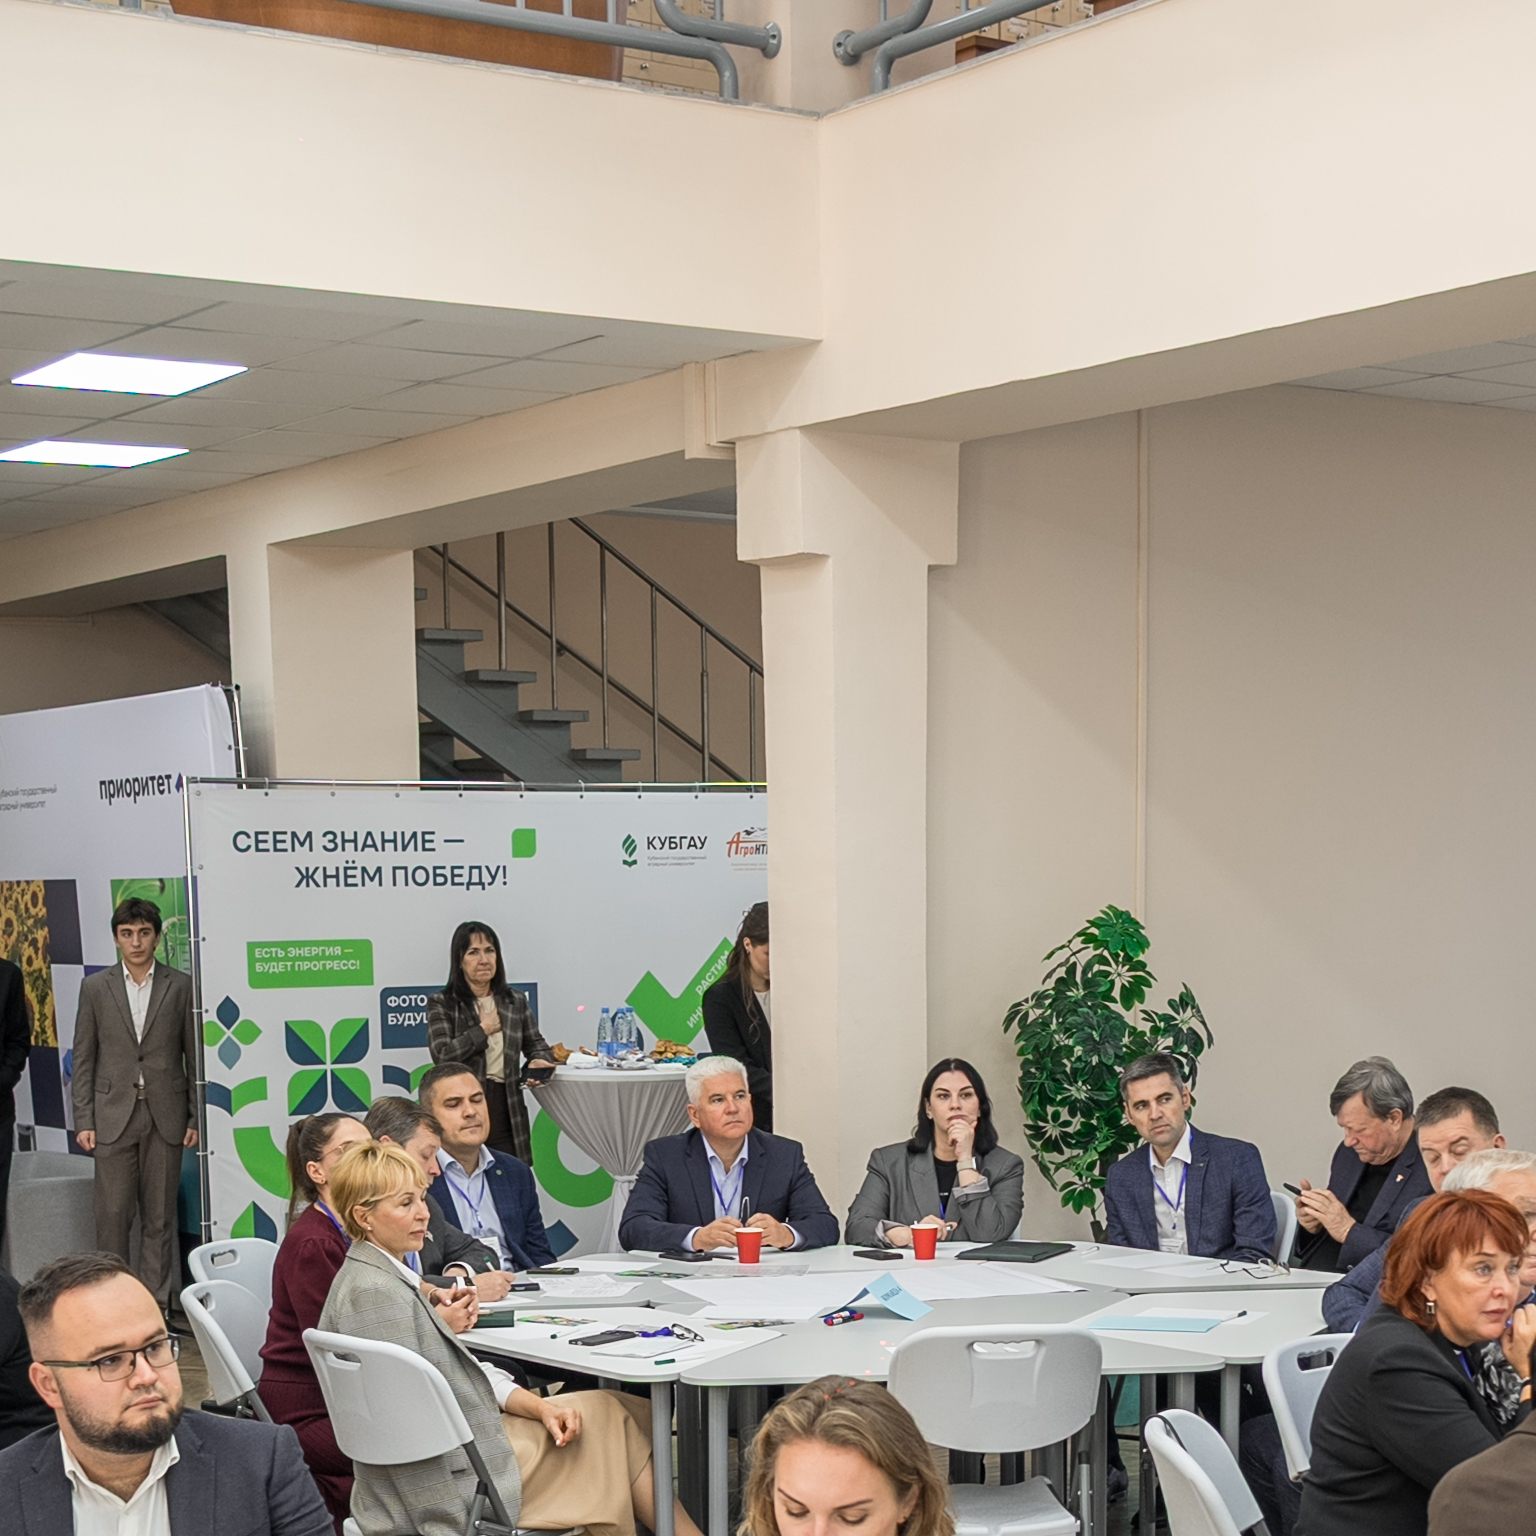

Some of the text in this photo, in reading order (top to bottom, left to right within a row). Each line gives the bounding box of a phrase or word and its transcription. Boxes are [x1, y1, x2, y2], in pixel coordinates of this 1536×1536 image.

[99, 773, 172, 806] приоритет
[232, 830, 313, 853] СЕЕМ
[321, 830, 436, 852] ЗНАНИЕ
[646, 836, 708, 850] КУБГАУ
[294, 859, 508, 891] ЖНЁМ ПОБЕДУ!
[255, 948, 285, 958] ЕСТЬ
[287, 946, 342, 958] ЭНЕРГИЯ
[255, 960, 360, 974] БУДЕТ ПРОГРЕСС!
[695, 950, 730, 996] РАСТИМ
